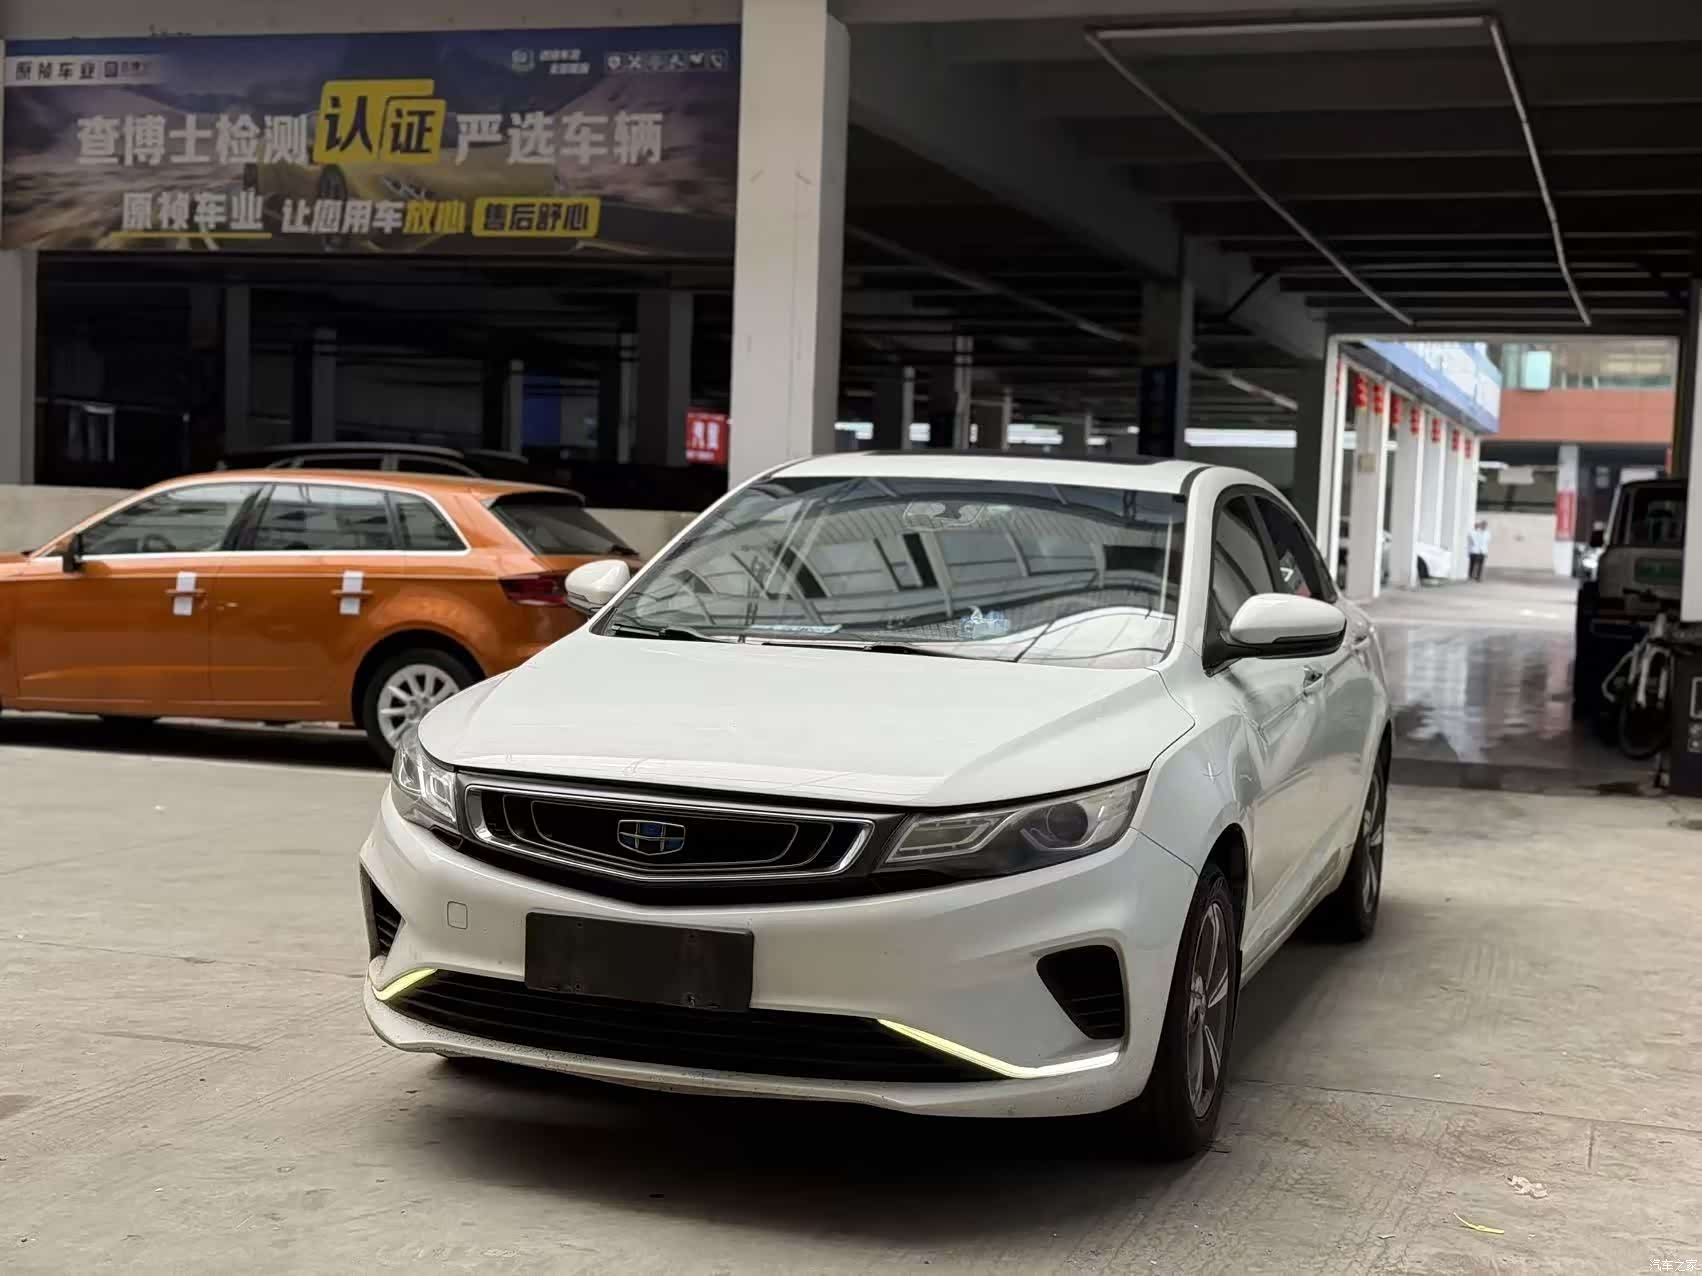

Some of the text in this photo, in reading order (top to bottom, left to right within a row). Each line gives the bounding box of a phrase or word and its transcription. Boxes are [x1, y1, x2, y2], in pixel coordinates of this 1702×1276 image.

[77, 96, 664, 167] 查博士检测 认证 严选车辆
[484, 203, 590, 232] 售后舒心
